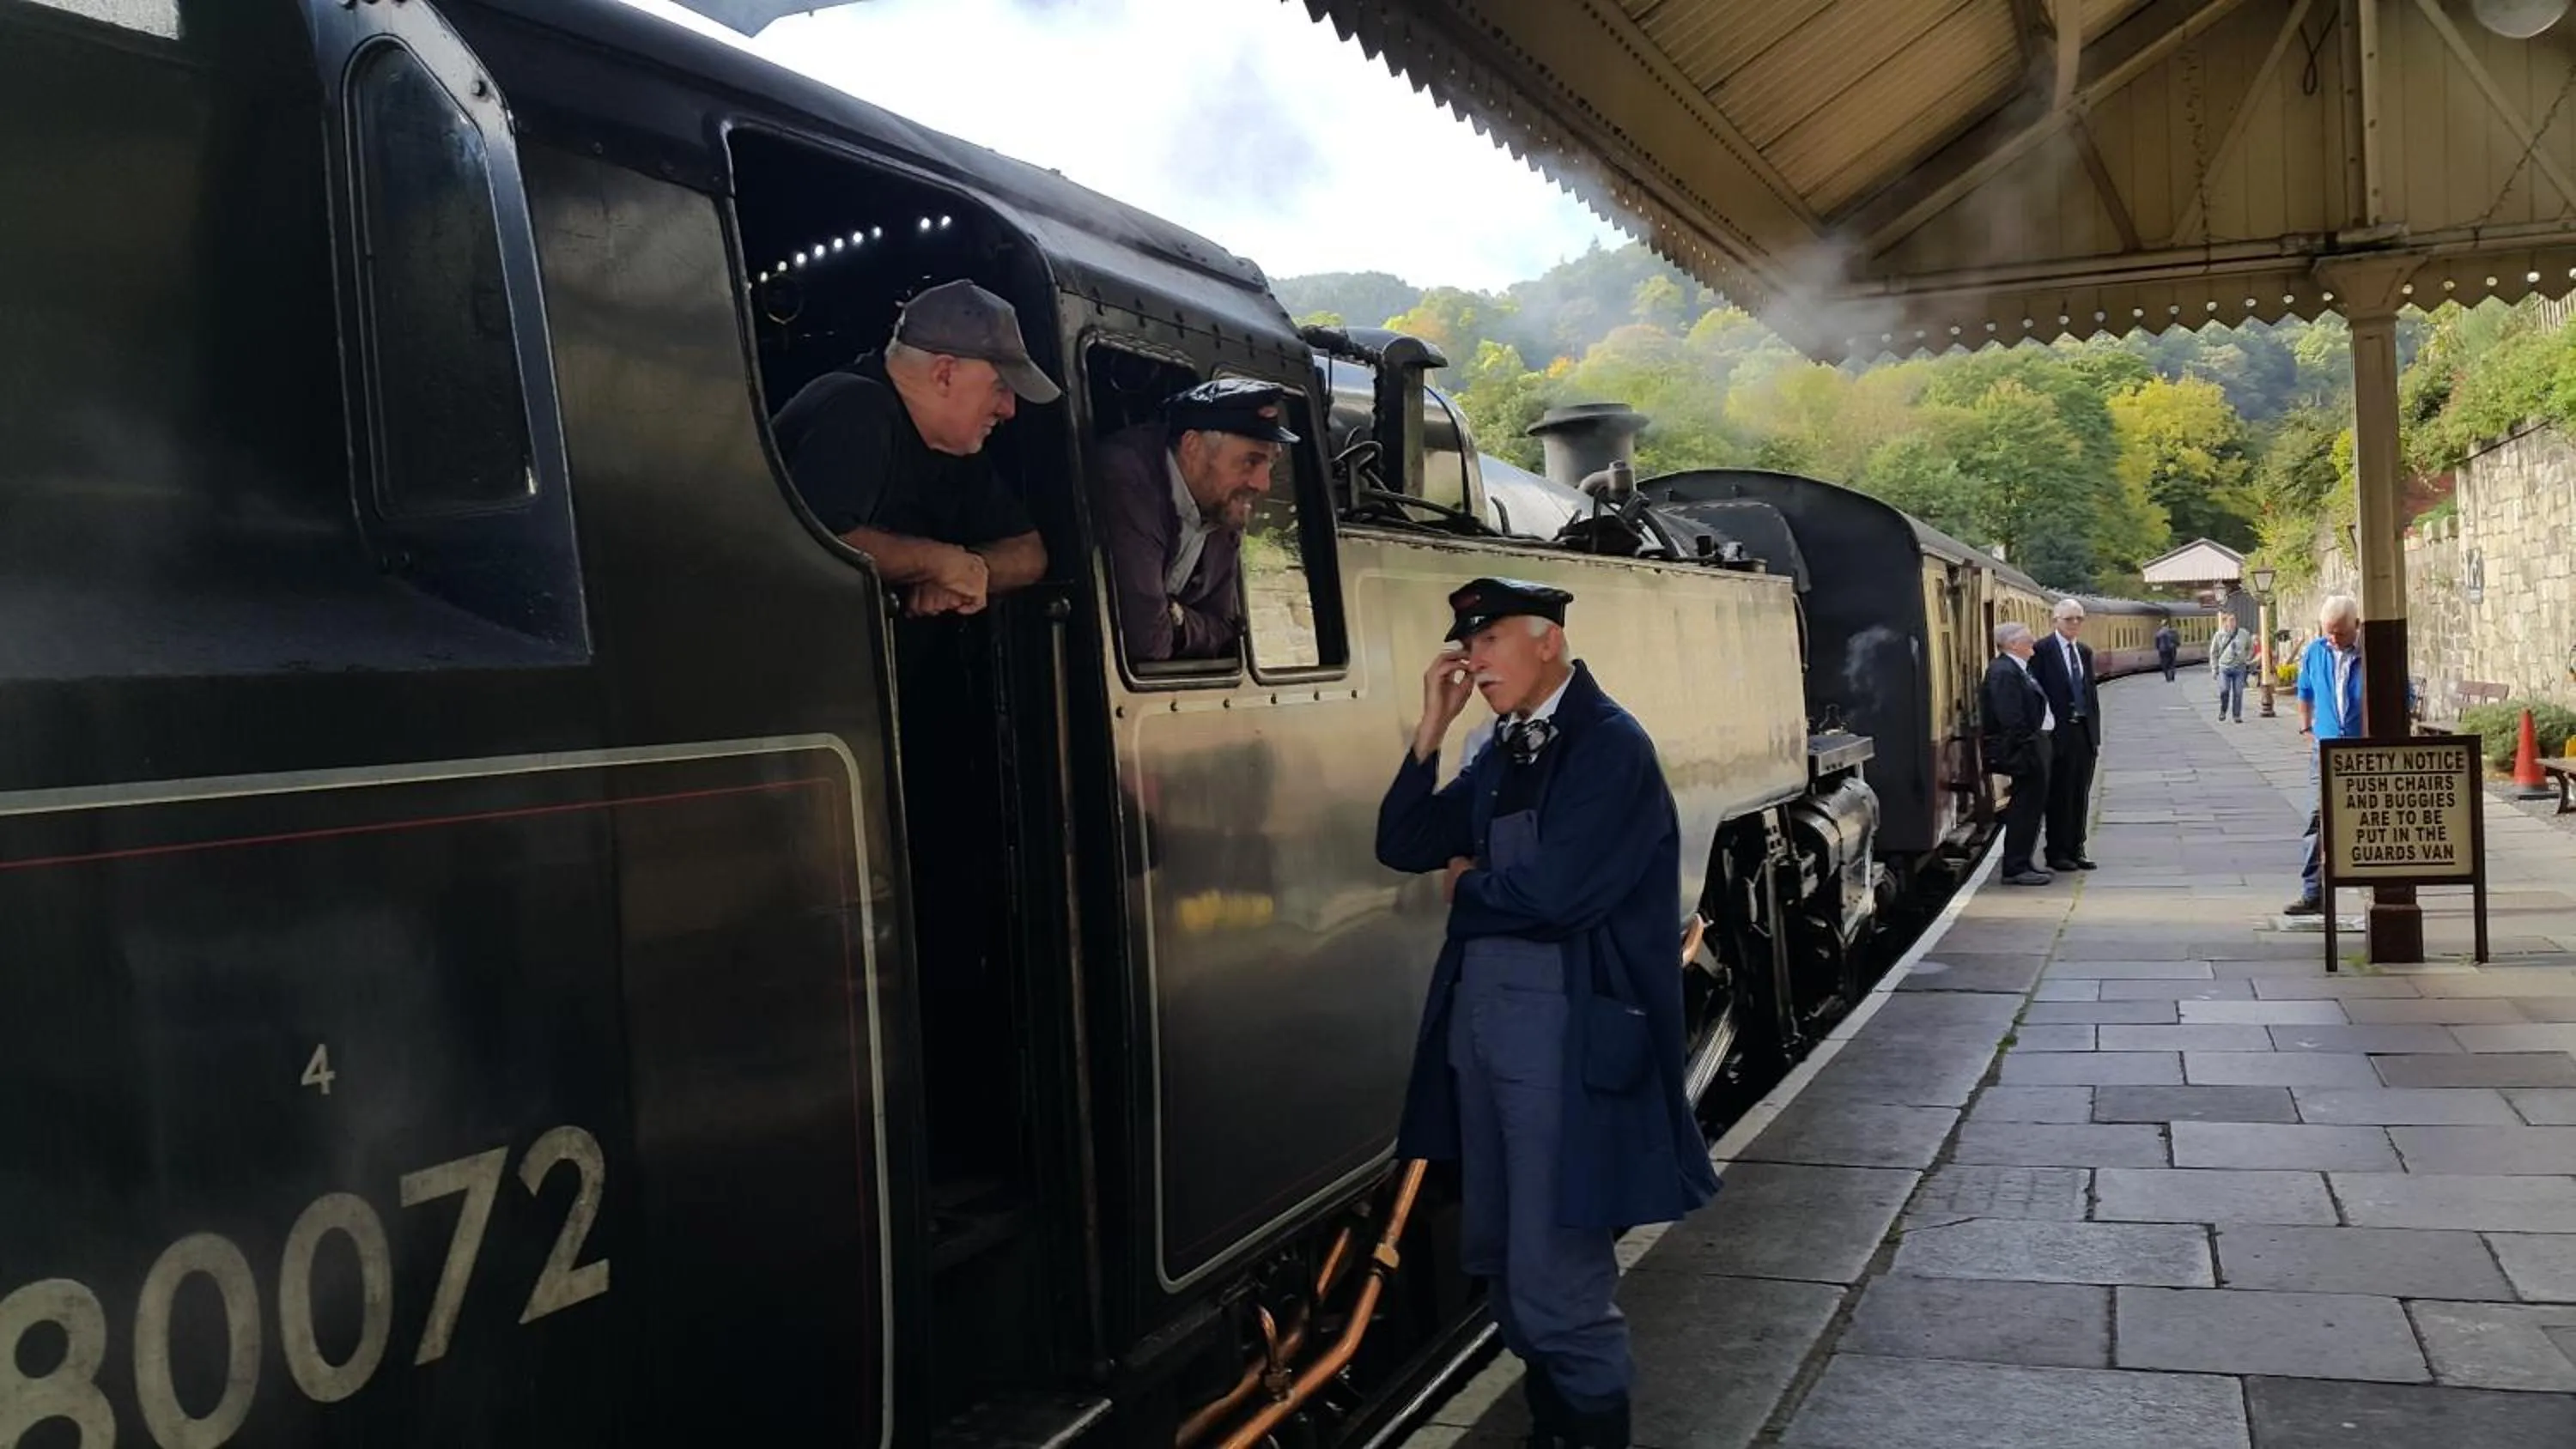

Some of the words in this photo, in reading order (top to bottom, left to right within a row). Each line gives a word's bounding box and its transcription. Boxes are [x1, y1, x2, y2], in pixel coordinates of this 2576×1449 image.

[2334, 752, 2396, 771] SAFETY
[2403, 751, 2464, 770] NOTICE
[2347, 778, 2387, 792] PUSH
[2395, 776, 2454, 791] CHAIRS
[2346, 794, 2378, 809] AND
[2385, 793, 2455, 808] BUGGIES
[2360, 811, 2390, 826] ARE
[2396, 811, 2416, 825] TO
[2423, 810, 2443, 824] BE
[2356, 828, 2385, 843] PUT
[2393, 828, 2409, 842] IN
[2416, 827, 2446, 841] THE
[2352, 846, 2415, 861] GUARDS
[2421, 845, 2454, 859] VAN
[301, 1043, 336, 1095] 4
[0, 1125, 610, 1449] 80072
